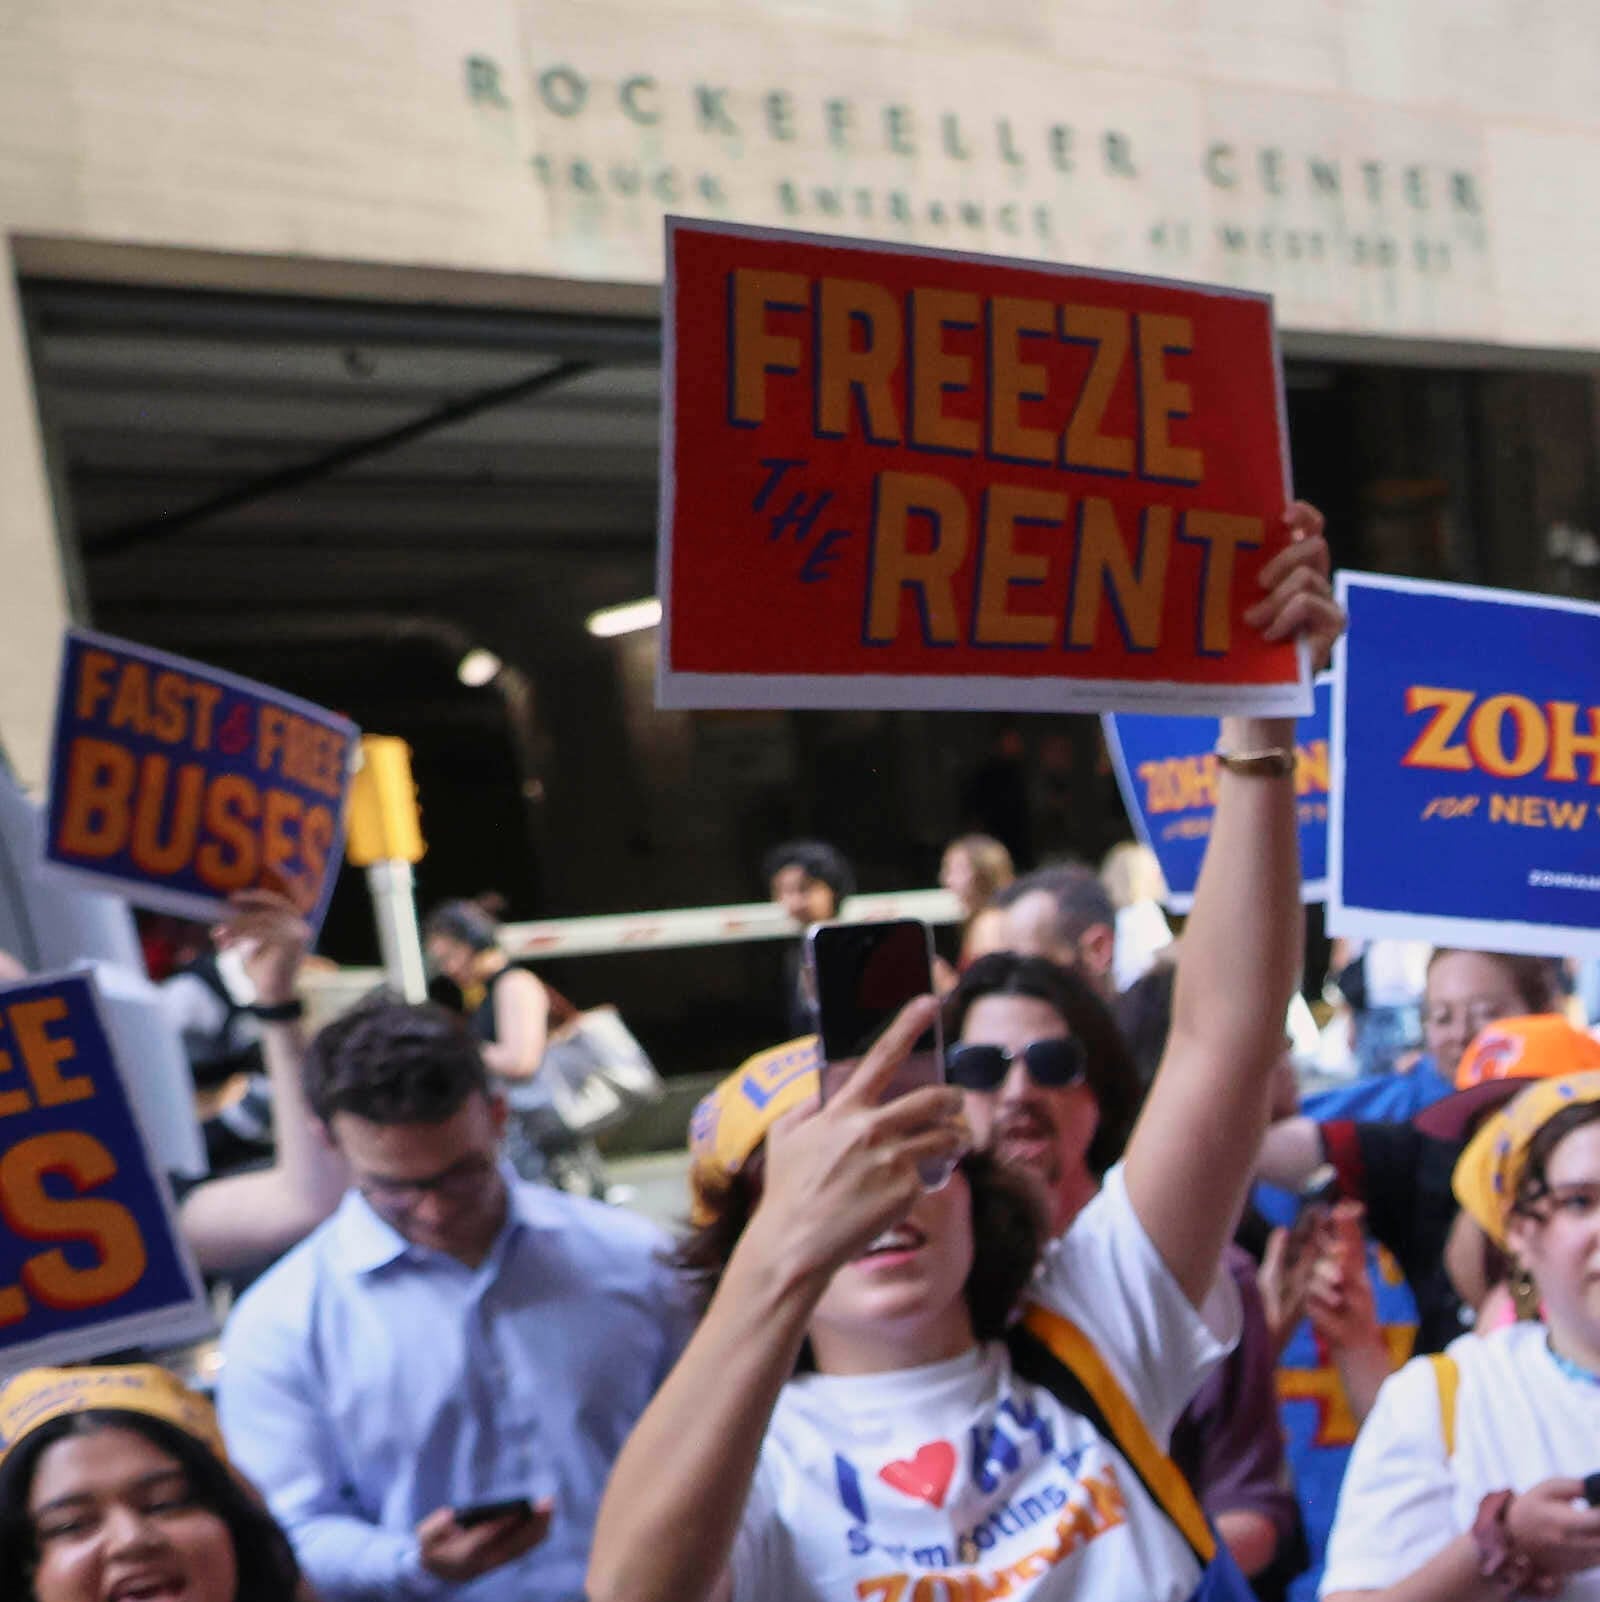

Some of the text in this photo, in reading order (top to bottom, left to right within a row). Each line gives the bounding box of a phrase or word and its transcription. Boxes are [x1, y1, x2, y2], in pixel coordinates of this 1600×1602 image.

[466, 53, 1486, 214] ROCKEFELLER CENTER
[727, 266, 1205, 487] FREEZE
[752, 458, 1264, 658] THE RENT
[75, 649, 222, 751] FAST
[258, 705, 346, 798] FREE
[58, 735, 334, 916] BUSES
[1488, 794, 1588, 832] NEW
